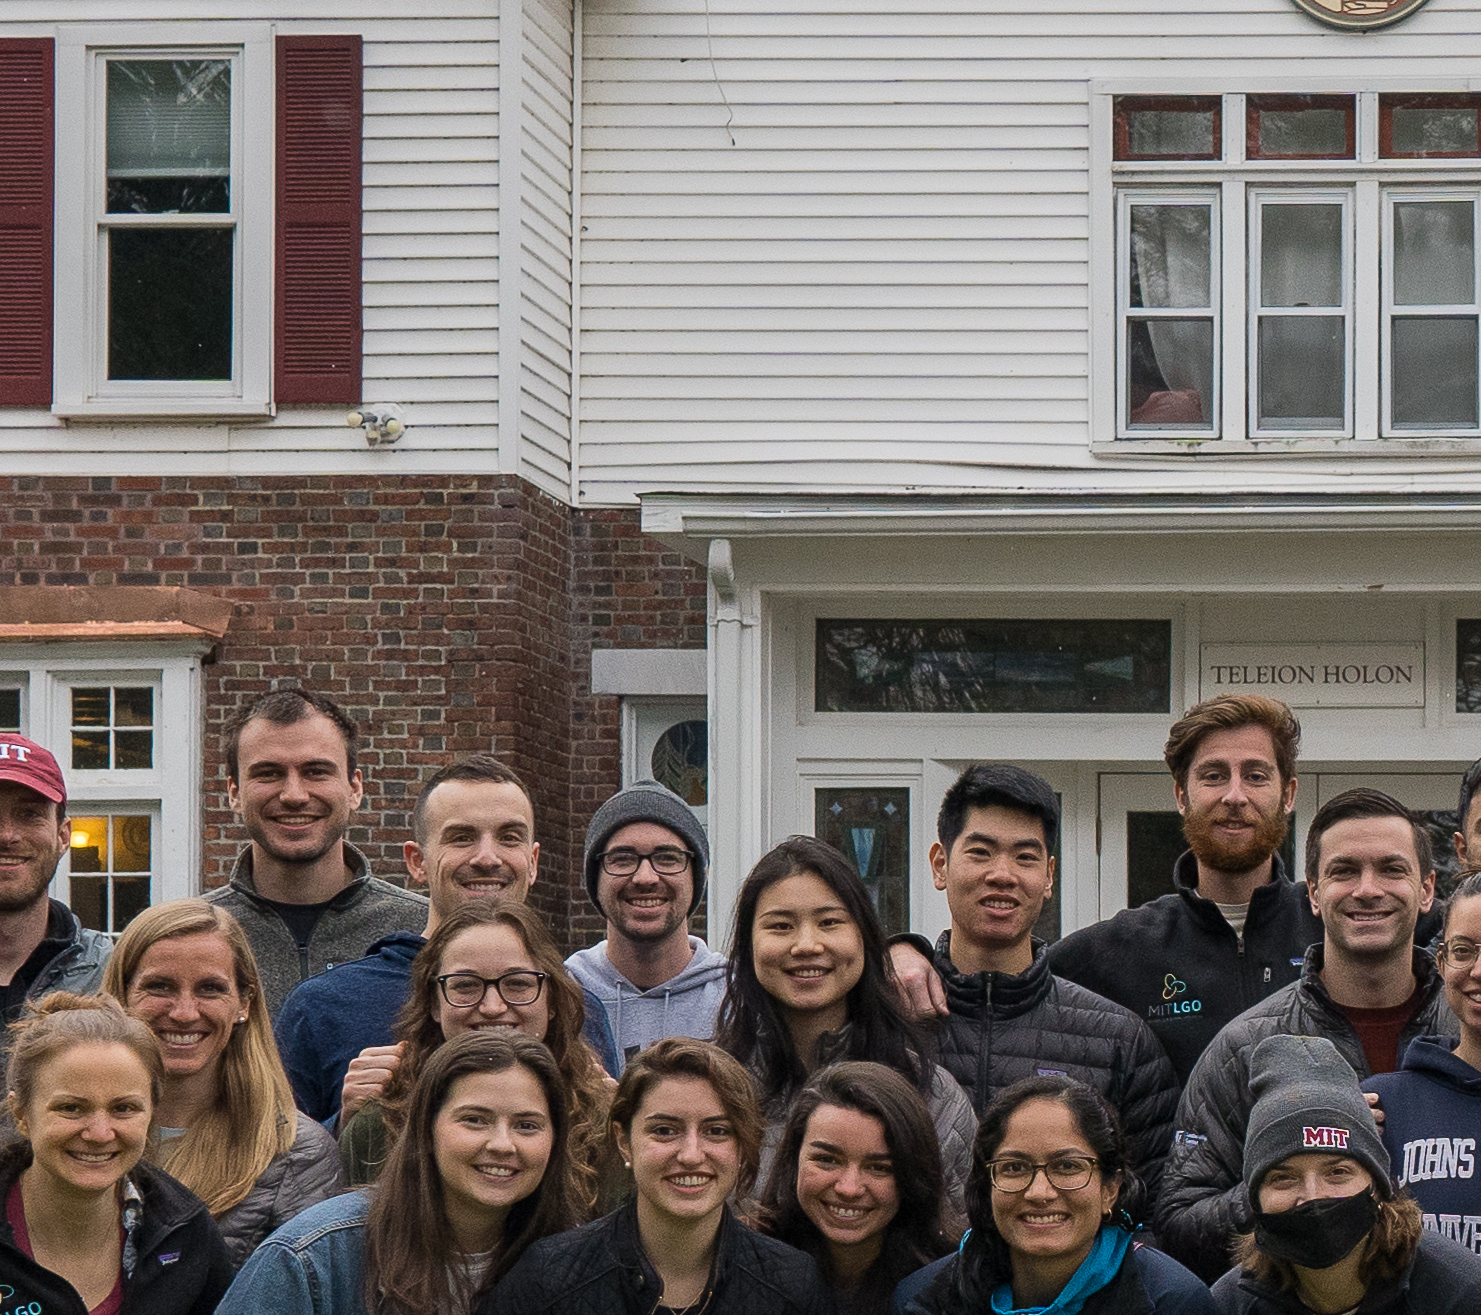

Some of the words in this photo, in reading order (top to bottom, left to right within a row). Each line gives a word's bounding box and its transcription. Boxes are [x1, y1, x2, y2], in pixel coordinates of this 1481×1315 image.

[1210, 664, 1316, 685] TELEION
[1323, 664, 1413, 685] HOLON
[1302, 1126, 1350, 1150] MIT
[1397, 1137, 1476, 1190] JOHNS
